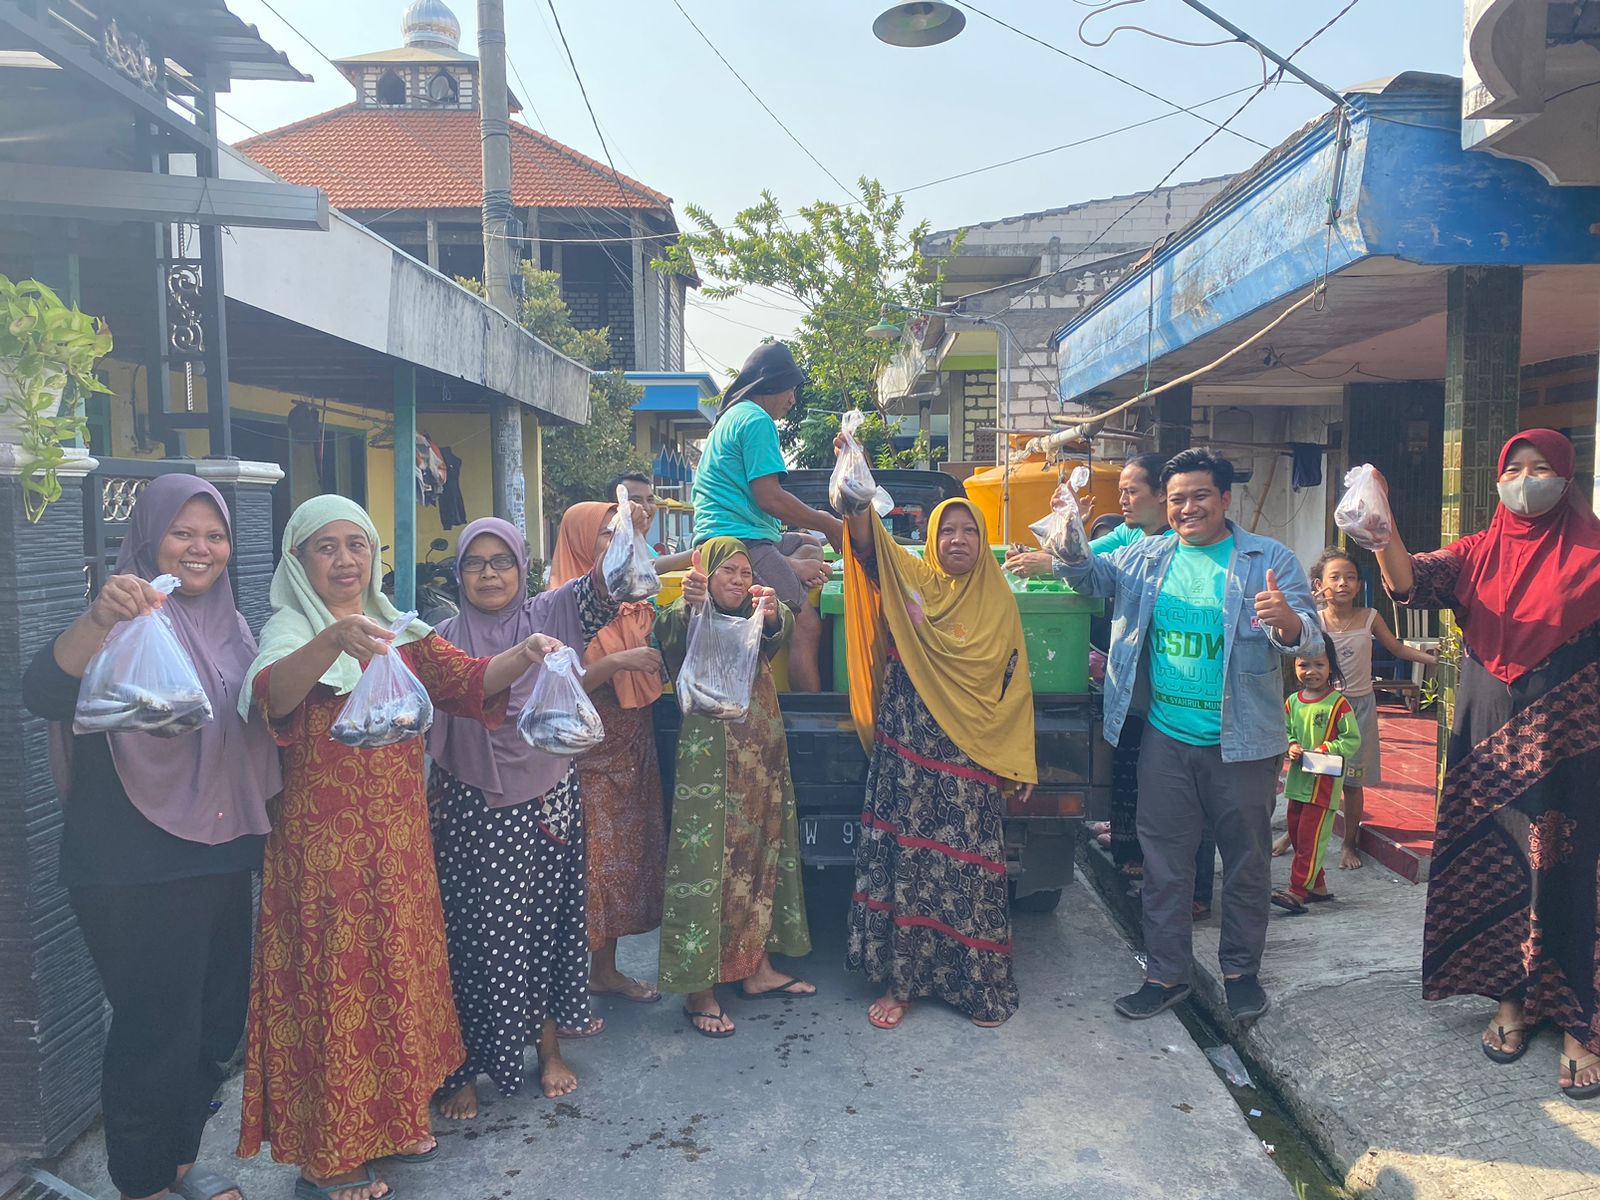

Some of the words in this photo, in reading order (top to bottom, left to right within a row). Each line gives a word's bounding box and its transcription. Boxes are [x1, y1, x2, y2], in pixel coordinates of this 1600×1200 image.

[1170, 696, 1201, 708] SYAHRUL
[805, 821, 818, 844] W
[843, 821, 860, 844] 9
